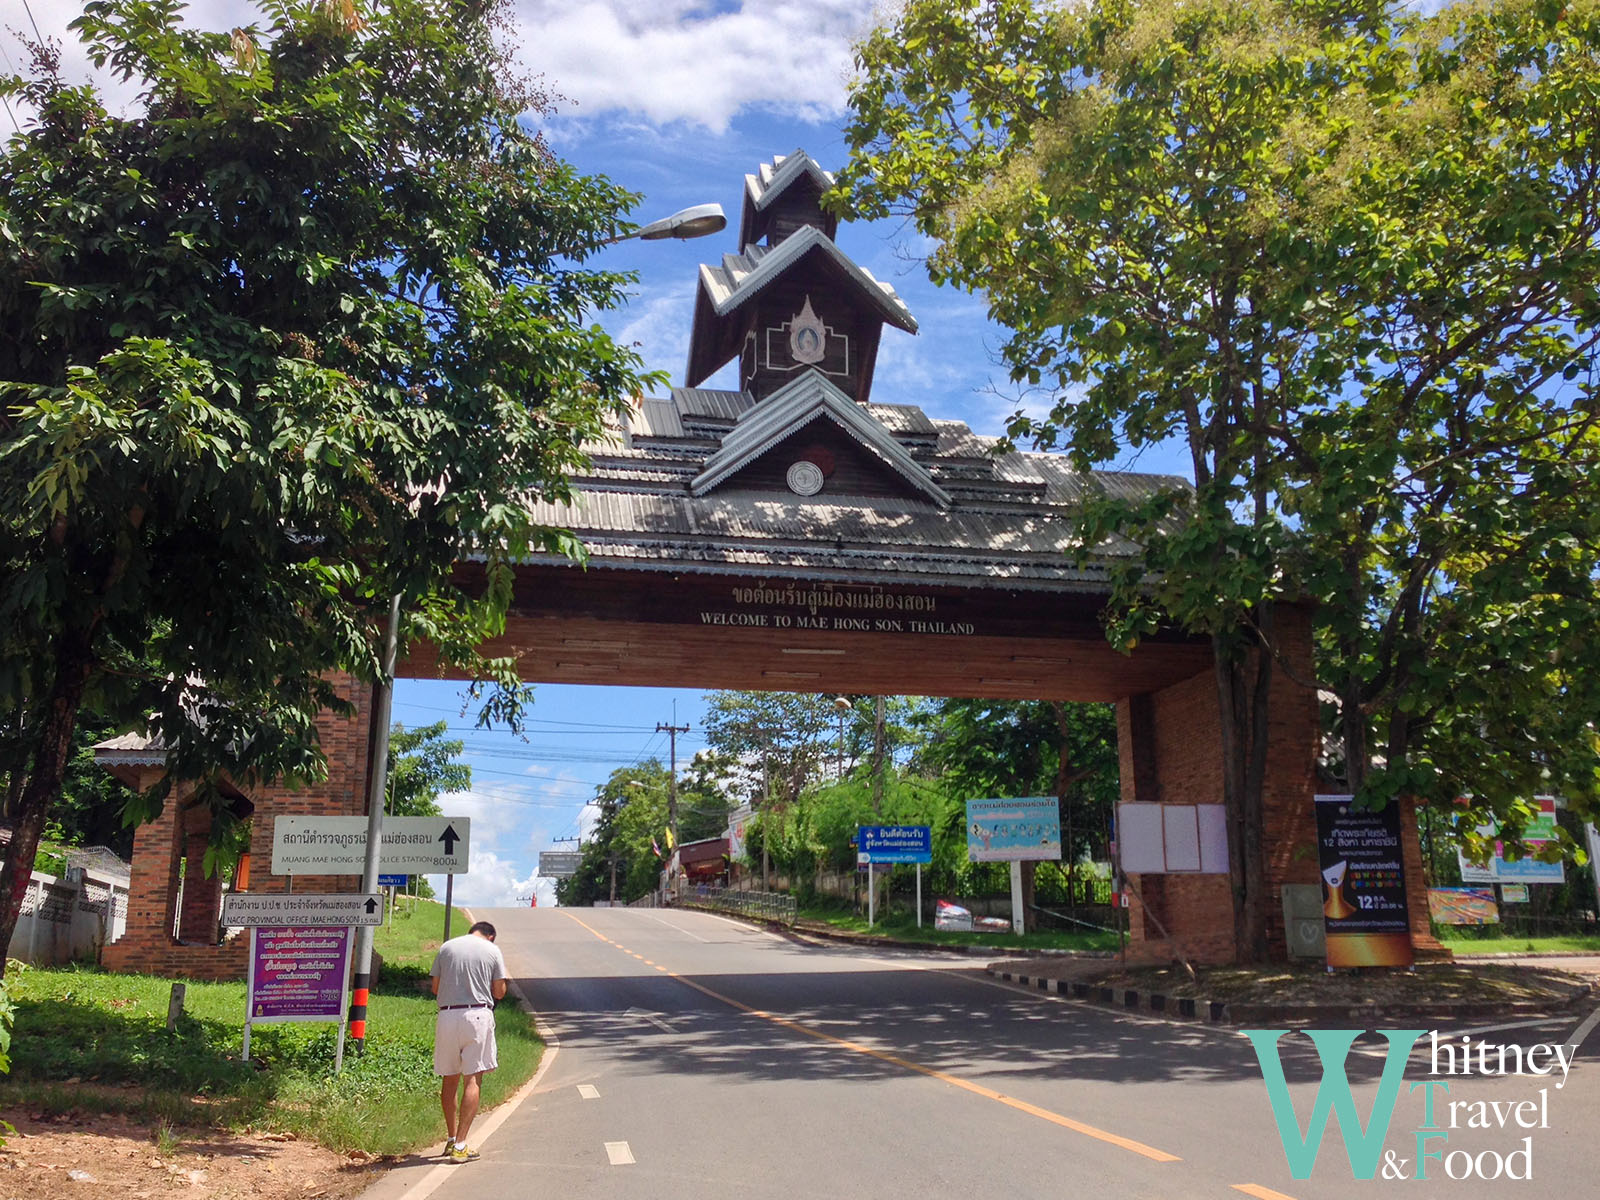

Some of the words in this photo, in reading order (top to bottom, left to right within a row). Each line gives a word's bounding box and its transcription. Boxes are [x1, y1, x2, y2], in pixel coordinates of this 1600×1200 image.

[731, 580, 936, 615] ขอต้อนรับสู่เมืองแม่ฮ่องสอน
[700, 612, 769, 627] WELCOME
[773, 615, 791, 628] TO
[796, 616, 828, 629] MAE
[834, 617, 870, 631] HONG
[908, 620, 975, 635] THAILAND
[1324, 838, 1334, 847] 12
[1361, 837, 1398, 847] มหาราชินี
[379, 856, 400, 864] OLICE
[401, 855, 433, 863] STATION
[228, 898, 260, 910] สำนักงาน
[1357, 895, 1373, 909] 12
[226, 916, 245, 924] NACC
[246, 916, 284, 924] PROVINCIAL
[285, 915, 309, 924] OFFICE
